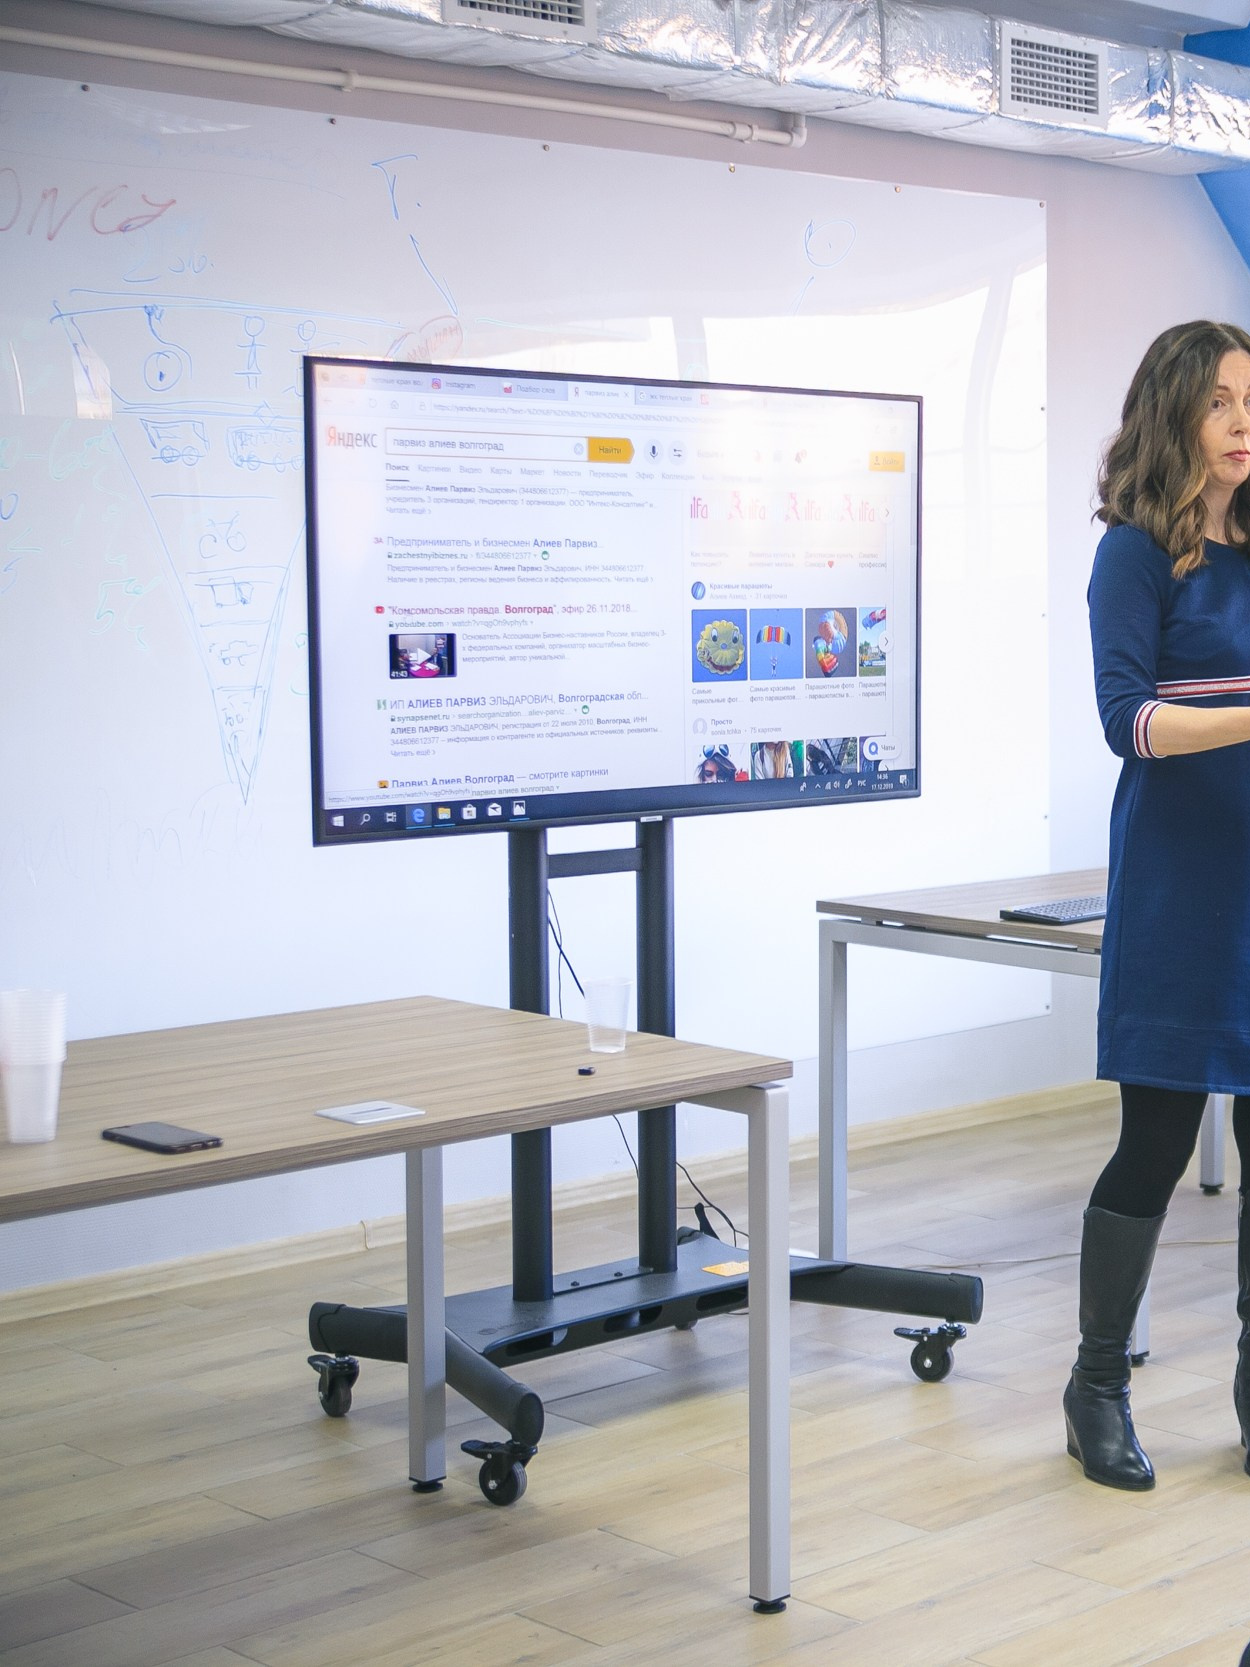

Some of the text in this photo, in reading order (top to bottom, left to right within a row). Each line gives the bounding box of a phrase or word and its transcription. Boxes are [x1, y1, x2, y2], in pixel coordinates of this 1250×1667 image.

[445, 380, 475, 390] Instagram
[516, 384, 556, 394] Подбор слов
[584, 389, 603, 397] парвиз
[326, 426, 378, 449] Яндекс
[392, 438, 504, 451] парвиз алиев волгоград
[598, 445, 622, 454] Найти
[385, 463, 695, 480] Поиск Картинки Видео Карты Маркет Новости Переводчик Эфир Коллекции
[385, 483, 423, 492] Бизнесмен
[425, 484, 448, 493] Алиев
[449, 485, 476, 493] Парвиз
[477, 485, 517, 494] Эльдарович
[385, 495, 425, 503] учредитель
[478, 497, 519, 505] гендиректор
[386, 506, 410, 514] Читать
[387, 537, 471, 547] Предприниматель
[482, 537, 530, 547] бизнесмен
[532, 538, 562, 548] Алиев
[388, 605, 465, 616] "Комсомольская
[560, 603, 584, 613] эфир
[394, 620, 444, 628] youtube.com
[542, 630, 604, 638] Бизнес-наставников
[467, 643, 512, 651] федеральных
[390, 670, 408, 678] 41:43
[769, 684, 795, 692] красивые
[390, 700, 404, 710] ИП
[407, 698, 441, 710] АЛИЕВ
[445, 697, 486, 708] ПАРВИЗ
[488, 694, 556, 706] ЭЛЬДАРОВИЧ,
[558, 691, 624, 703] Волгоградская
[691, 697, 725, 705] прикольные
[808, 692, 845, 700] парашютисты
[397, 713, 449, 723] synapsenet.ru
[390, 727, 417, 735] АЛИЕВ
[418, 725, 448, 734] ПАРВИЗ
[501, 721, 541, 729] регистрация
[757, 725, 781, 733] карточек
[390, 737, 439, 746] 344806612377
[446, 734, 489, 743] информация
[496, 732, 535, 741] контрагенте
[545, 729, 588, 738] официальных
[390, 748, 430, 758] Читать ещё
[464, 772, 514, 785] Волгоград
[528, 770, 568, 780] смотрите
[570, 768, 609, 777] картинки
[471, 784, 554, 797] парвиз алиев волгоград
